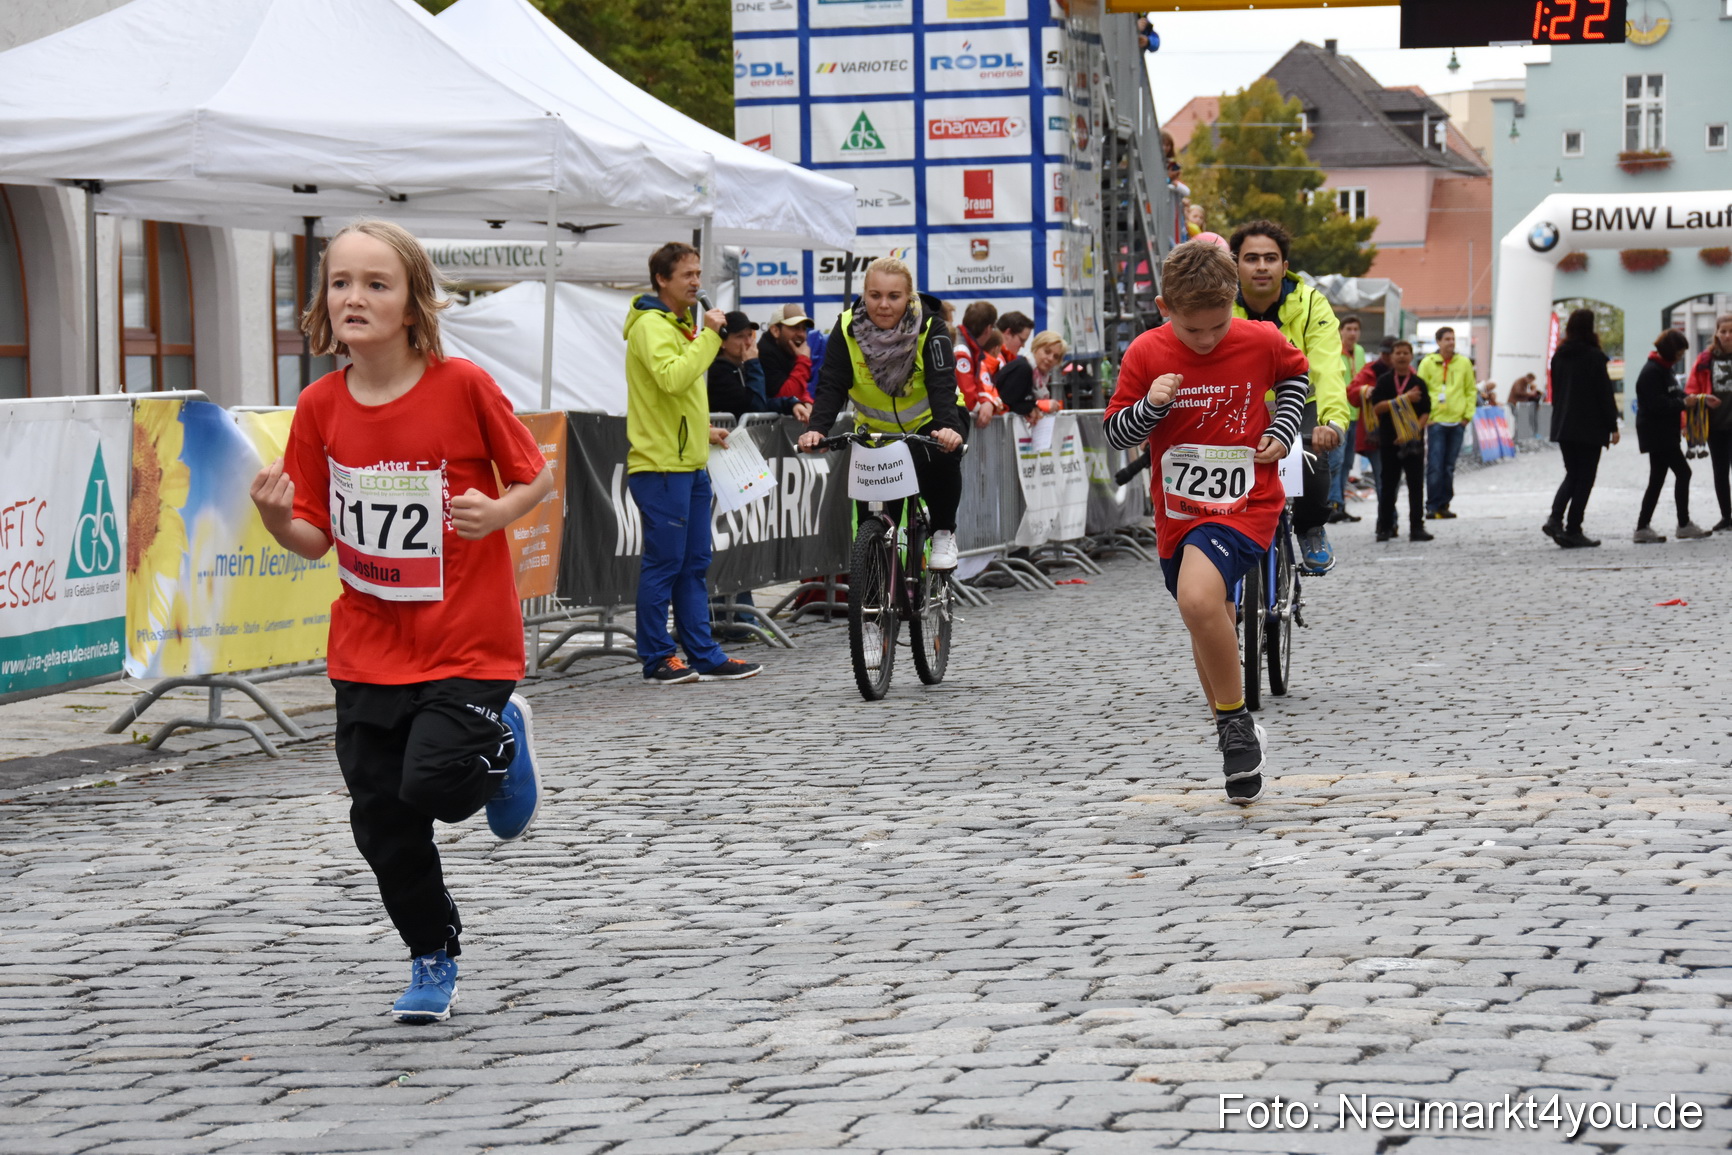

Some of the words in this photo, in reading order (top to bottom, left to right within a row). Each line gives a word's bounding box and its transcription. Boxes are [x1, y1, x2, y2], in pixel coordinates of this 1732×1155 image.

[1532, 0, 1611, 40] 1:22
[930, 46, 1023, 70] RÖDL
[840, 59, 908, 73] VARIOTEC
[979, 68, 1023, 80] energie
[750, 77, 794, 88] energie
[932, 116, 1000, 135] charivari
[964, 196, 992, 210] Braun
[1571, 206, 1656, 231] BMW
[1666, 205, 1732, 230] Lauf
[957, 265, 1005, 274] Neumarkter
[756, 276, 798, 287] energie
[948, 274, 1014, 285] Lammsbräu
[1205, 448, 1249, 460] BOCK
[854, 460, 875, 472] Erster
[877, 459, 904, 471] Mann
[359, 474, 430, 491] BOCK
[857, 472, 903, 487] Jugendlauf
[1172, 462, 1246, 499] 7230
[1180, 500, 1201, 514] Ben
[335, 490, 429, 550] 7172
[431, 547, 437, 555] K
[1216, 544, 1230, 557] JAKO
[353, 554, 401, 582] Joshua
